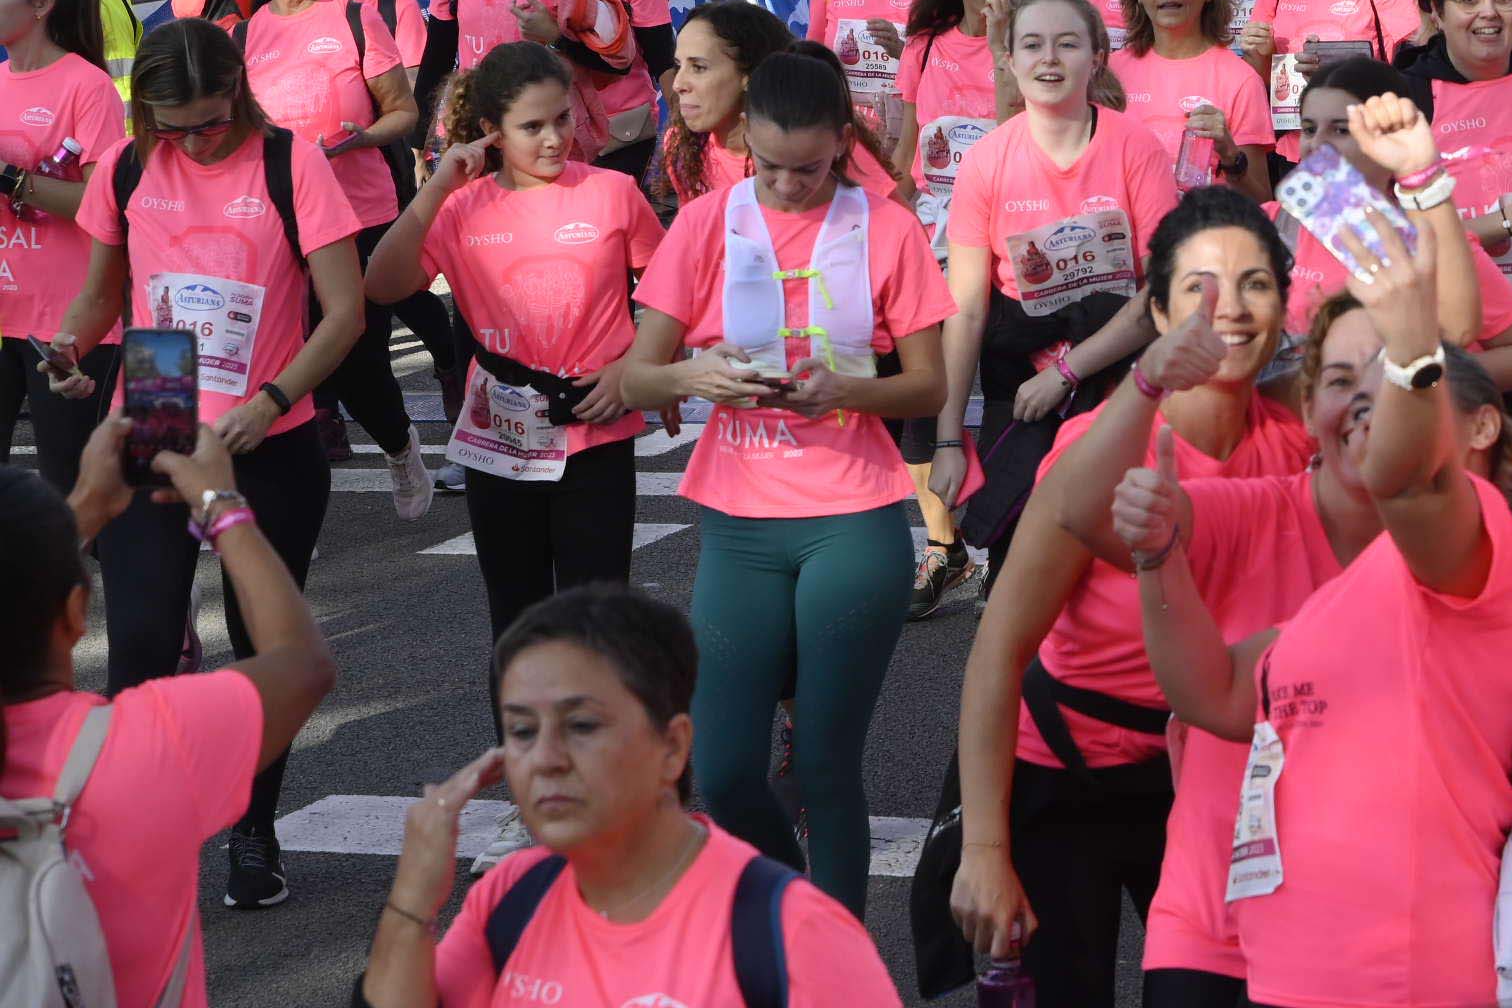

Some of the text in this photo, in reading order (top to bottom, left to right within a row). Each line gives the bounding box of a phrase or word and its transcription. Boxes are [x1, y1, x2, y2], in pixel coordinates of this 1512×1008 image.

[834, 0, 865, 8] OYSHO
[863, 50, 890, 62] 016
[1440, 116, 1487, 134] OYSHO
[1005, 200, 1049, 213] OYSHO
[1056, 250, 1096, 271] 016
[1062, 266, 1095, 282] 29792
[1034, 285, 1066, 298] CARRERA
[1034, 296, 1071, 311] OYSHO
[480, 328, 511, 354] TU
[493, 413, 526, 436] 016
[467, 435, 500, 451] CARRERA
[458, 448, 495, 466] OYSHO
